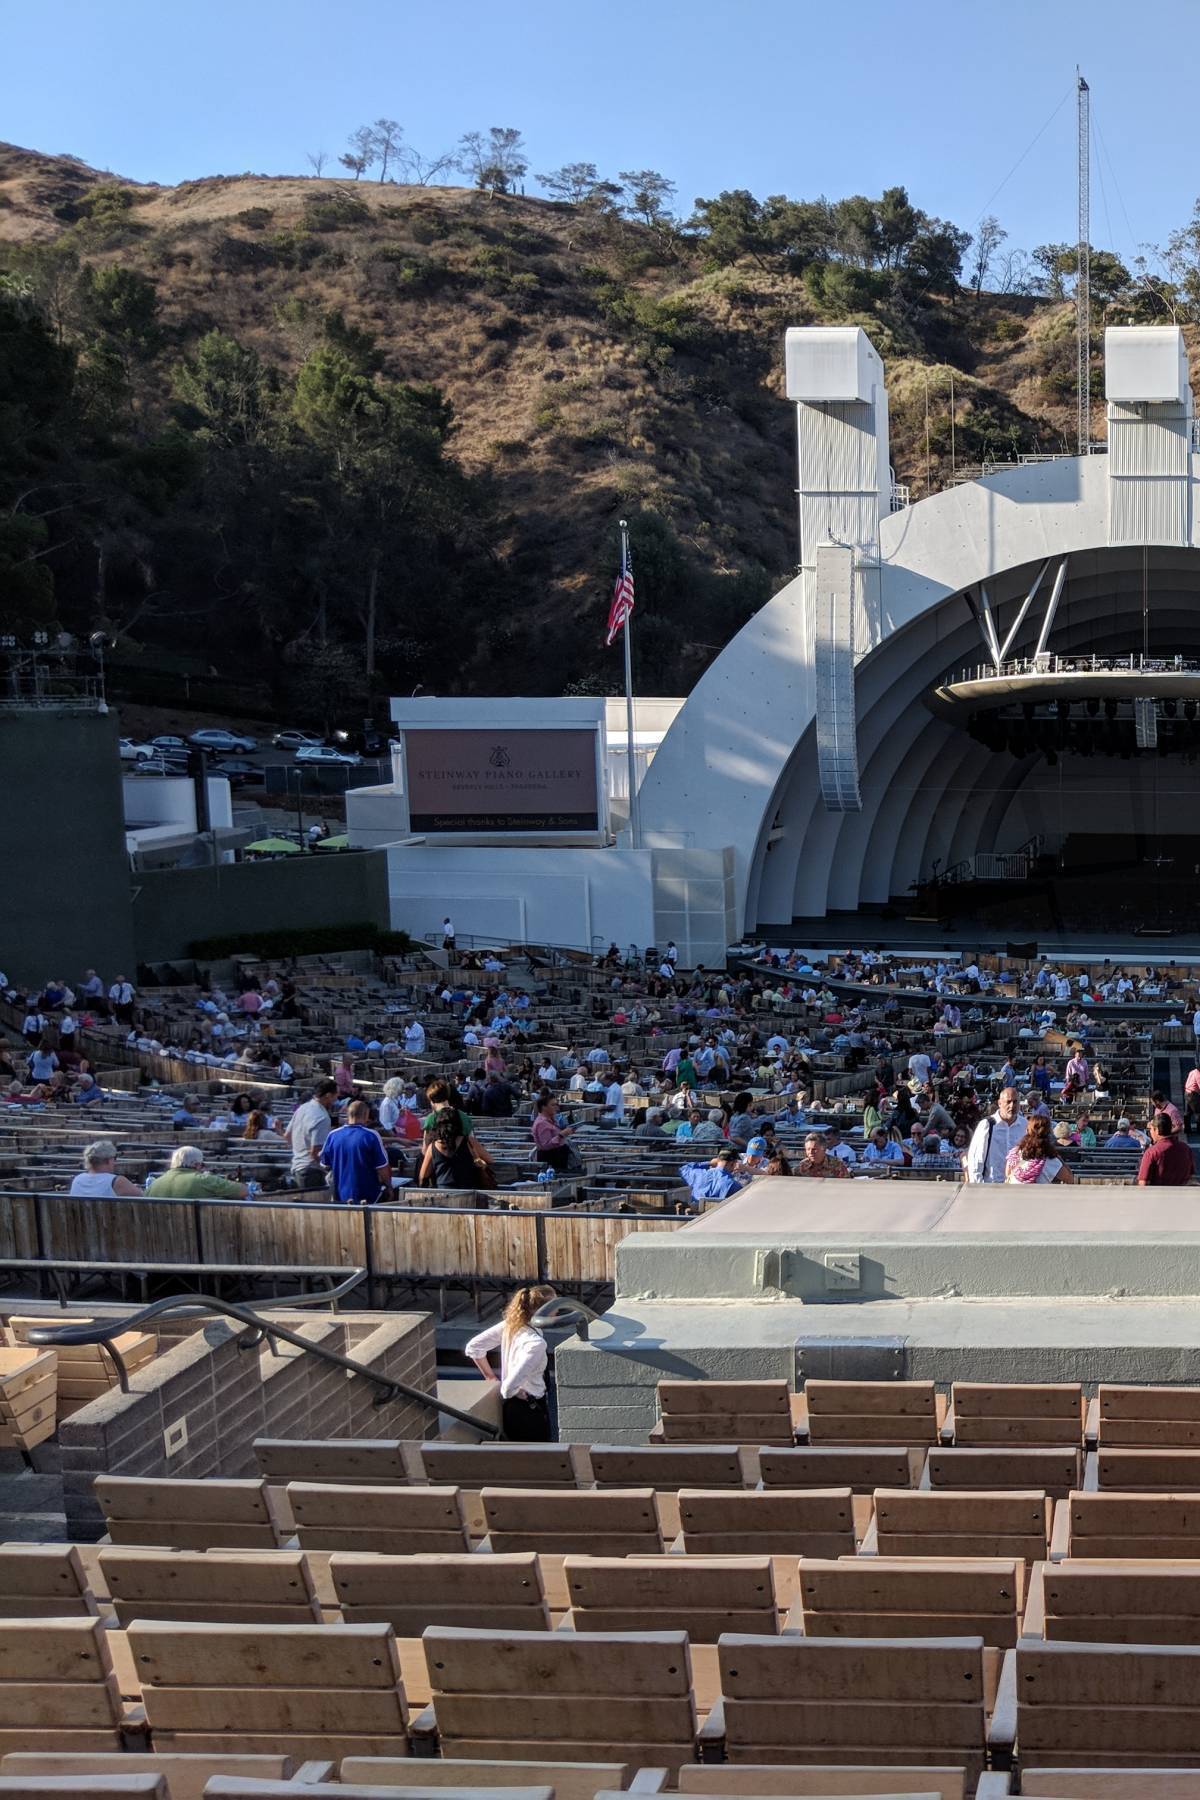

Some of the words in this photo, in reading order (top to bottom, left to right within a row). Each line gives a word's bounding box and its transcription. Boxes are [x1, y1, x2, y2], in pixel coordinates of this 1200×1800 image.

[417, 769, 480, 780] STEINWAY
[485, 769, 522, 780] PIANO
[528, 769, 583, 780] GALLERY
[434, 817, 465, 828] Special
[497, 817, 505, 825] to
[509, 816, 545, 827] Steinway
[558, 815, 578, 824] Sons
